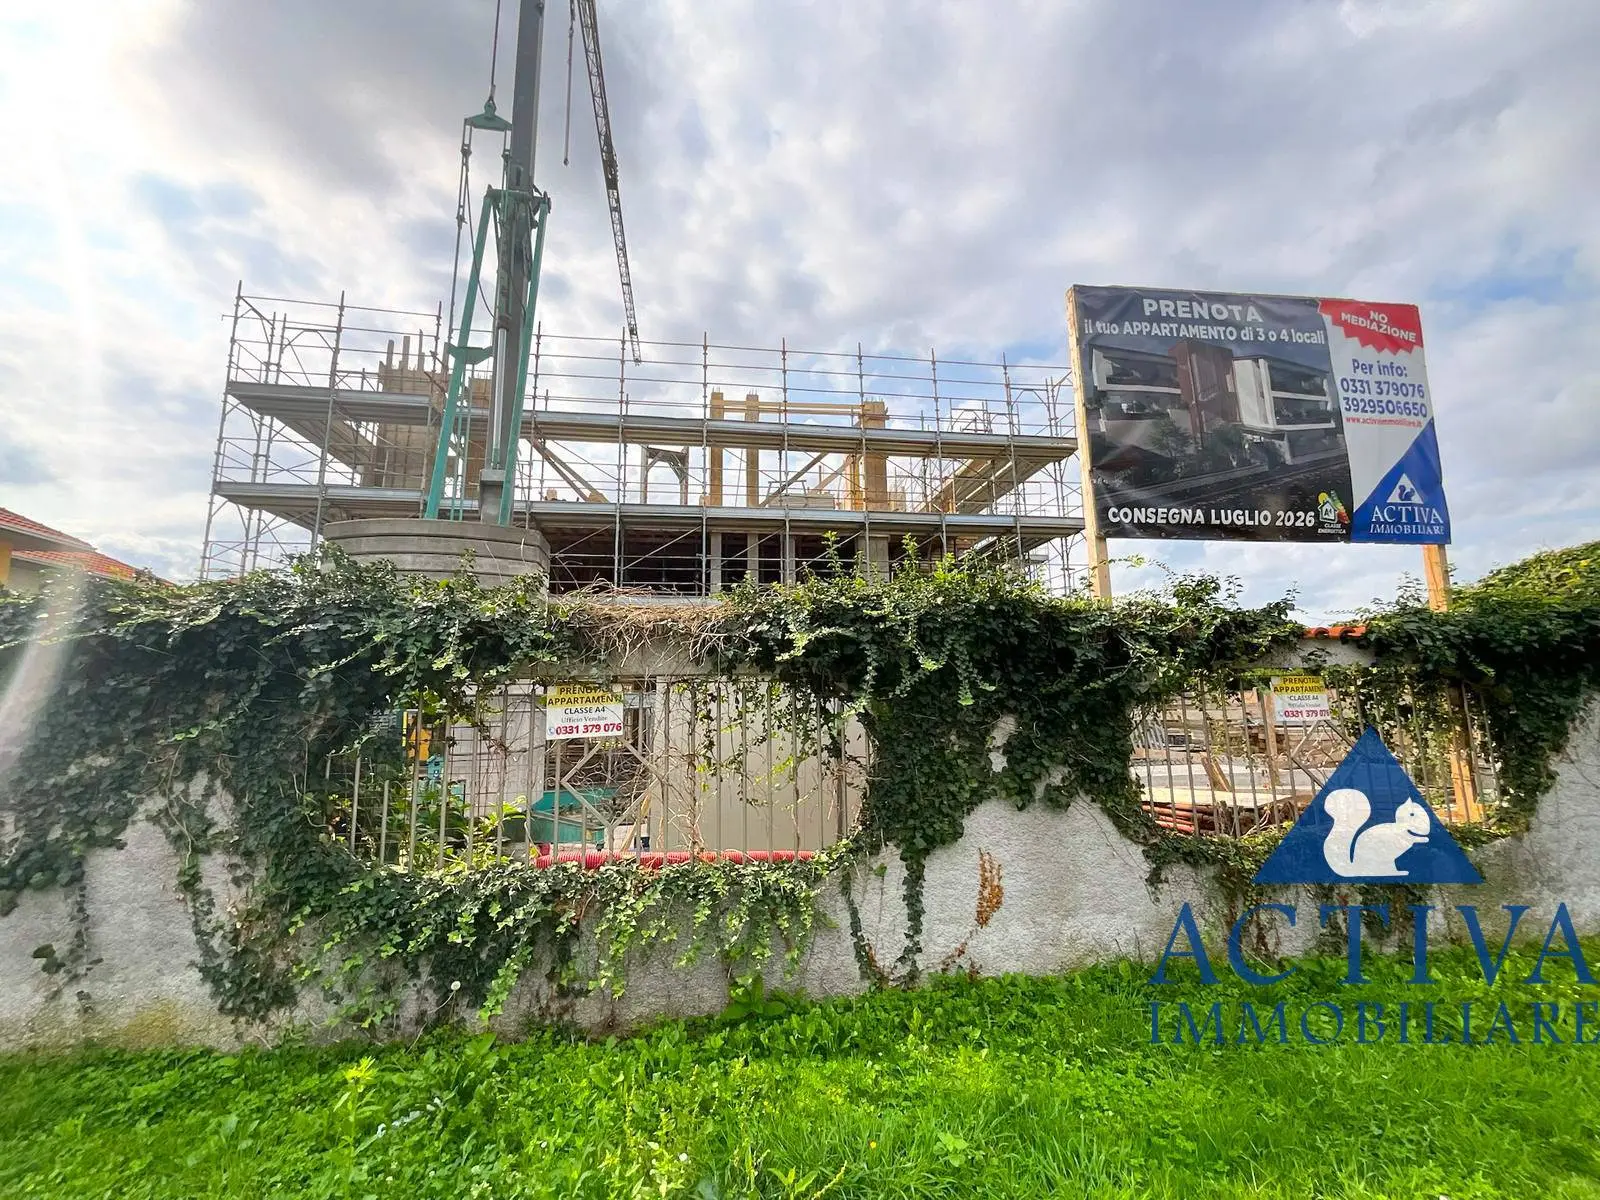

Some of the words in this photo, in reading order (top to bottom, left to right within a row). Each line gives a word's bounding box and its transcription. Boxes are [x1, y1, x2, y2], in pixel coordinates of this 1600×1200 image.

[1143, 299, 1264, 323] PRENOTA
[1369, 310, 1388, 323] NO
[1084, 319, 1094, 334] il
[1096, 320, 1119, 335] tuo
[1123, 321, 1237, 341] APPARTAMENTO
[1240, 326, 1254, 341] di
[1256, 328, 1265, 341] 3
[1268, 331, 1277, 342] o
[1279, 329, 1289, 343] 4
[1291, 329, 1325, 345] locali
[1341, 312, 1416, 342] MEDIAZIONE
[1352, 359, 1374, 375] Per
[1377, 360, 1408, 378] info:
[1340, 378, 1371, 395] 0331
[1375, 381, 1425, 399] 379076
[1342, 397, 1428, 418] 3929506650
[1107, 507, 1205, 524] CONSEGNA
[1210, 509, 1272, 526] LUGLIO
[1275, 510, 1315, 527] 2026
[1371, 505, 1444, 524] ACTIVA
[1370, 524, 1445, 535] IMMOBILIARE
[564, 707, 593, 715] CLASSE
[1284, 710, 1304, 718] 0331
[1305, 709, 1319, 718] 379
[555, 725, 580, 736] 0331
[582, 724, 601, 734] 379
[603, 722, 622, 733] 076
